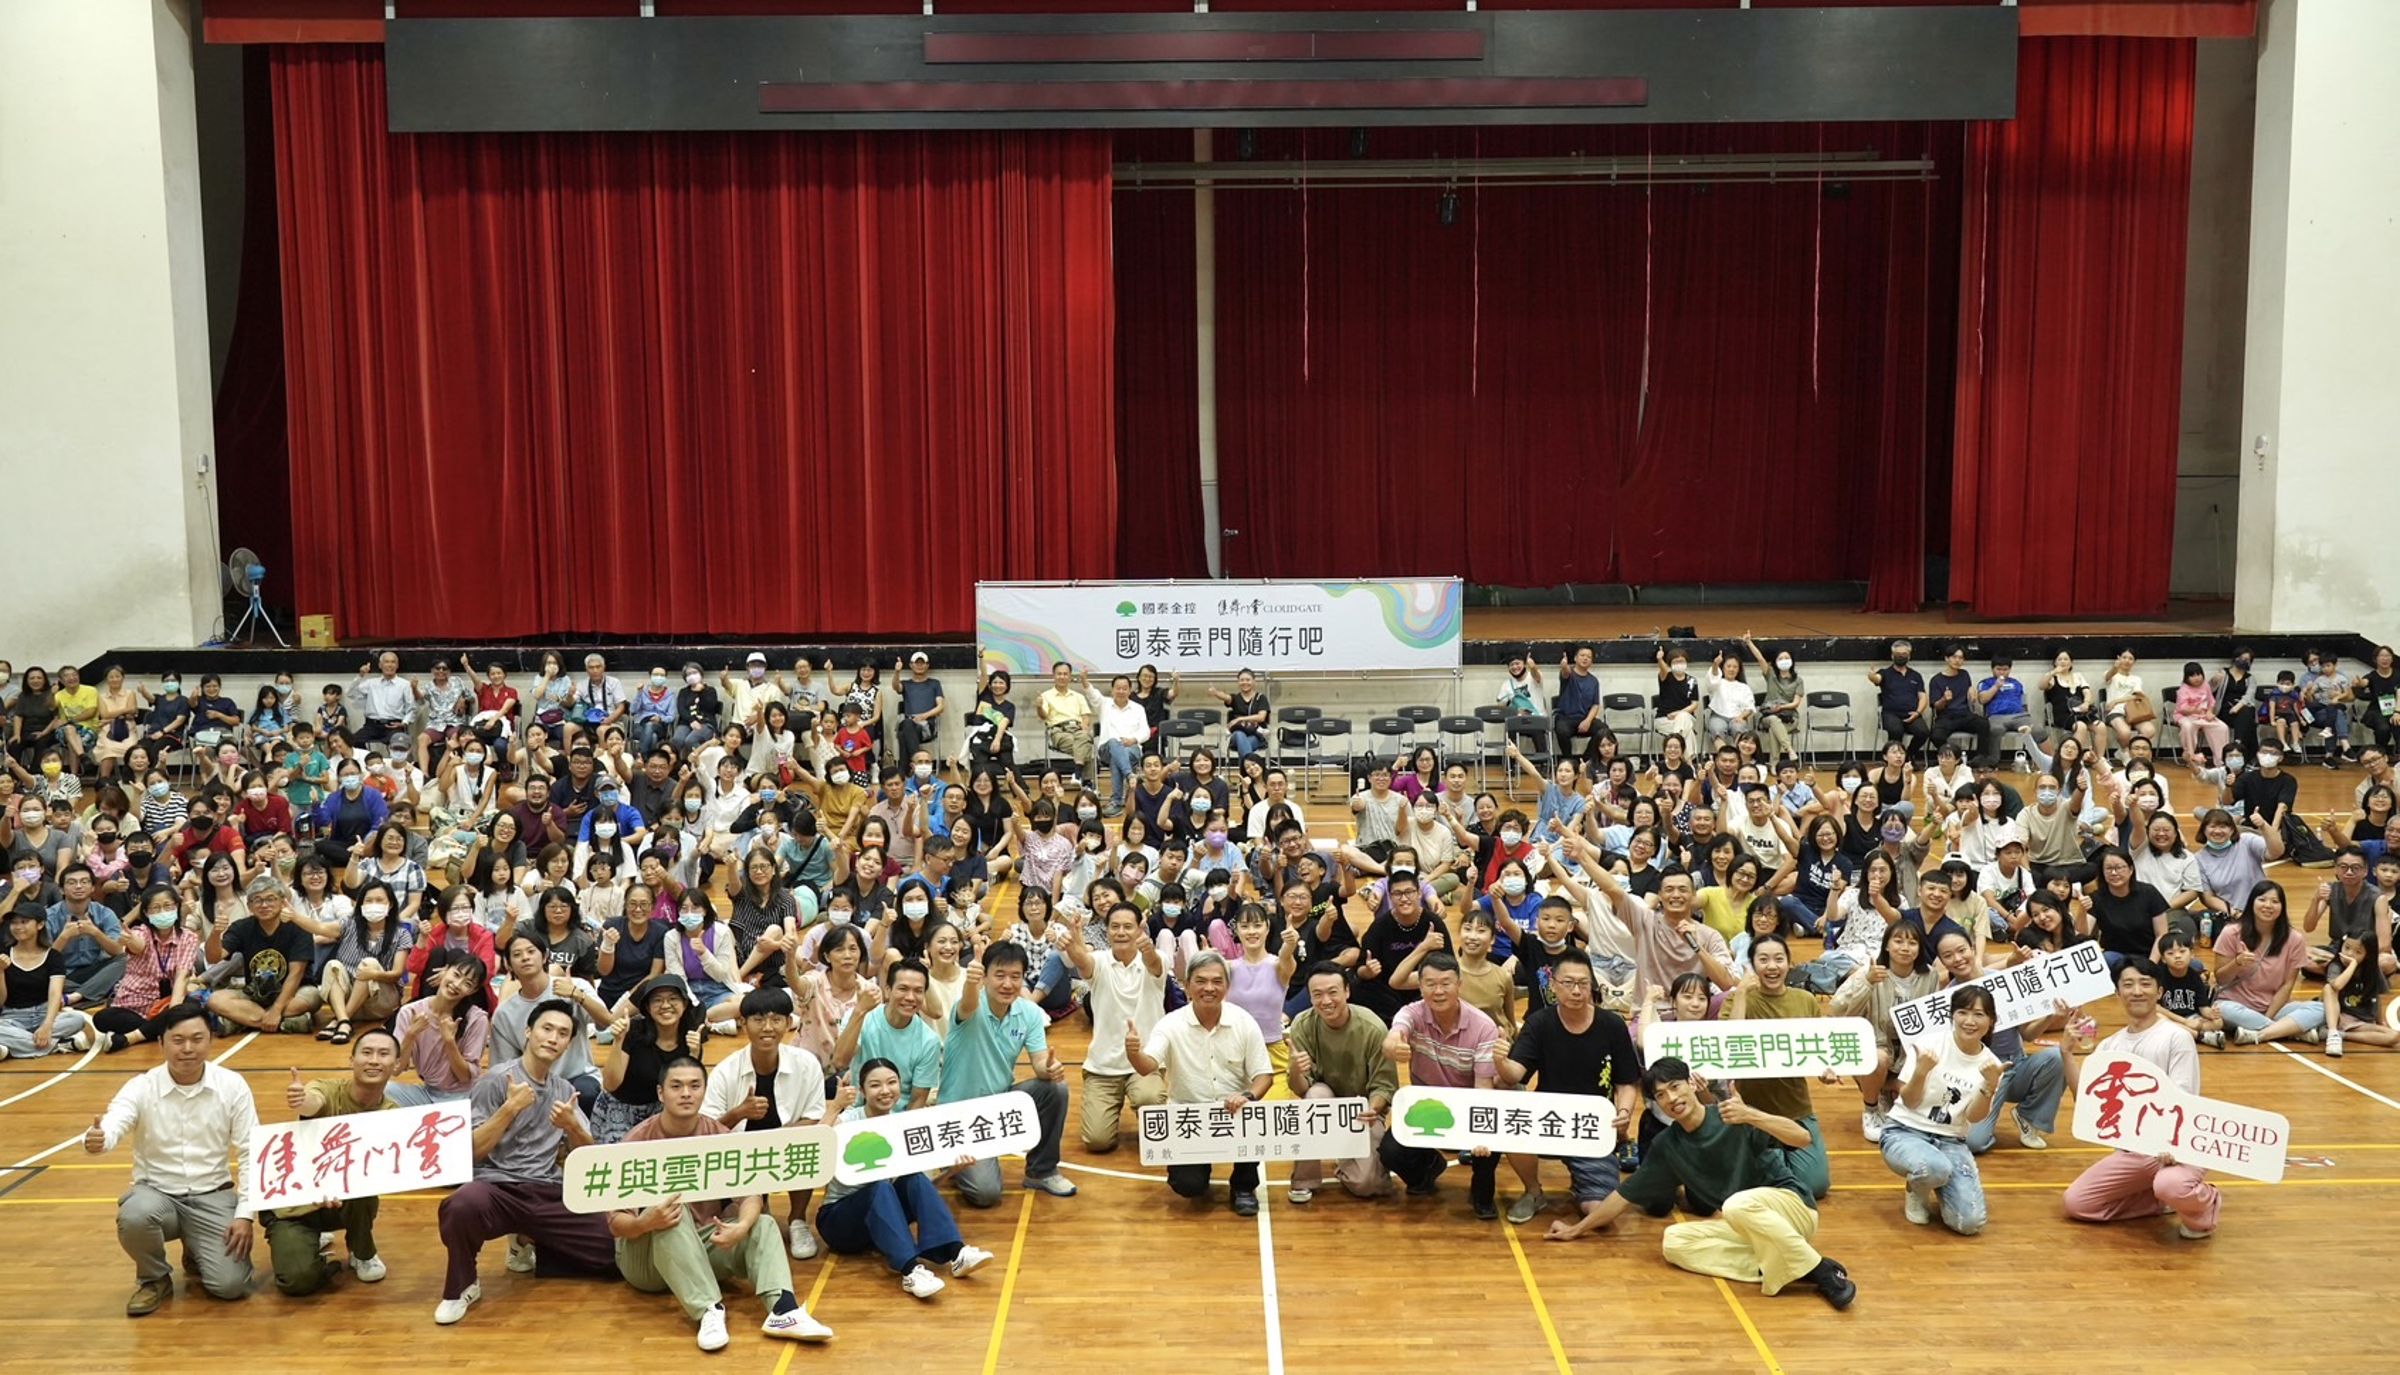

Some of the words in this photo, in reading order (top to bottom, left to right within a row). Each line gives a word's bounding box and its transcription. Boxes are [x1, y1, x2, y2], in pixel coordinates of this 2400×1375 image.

[1142, 602, 1197, 615] 國泰金控
[1115, 626, 1324, 660] 國泰雲門隨行吧
[1894, 945, 2104, 1036] 國泰門隨行吧
[1661, 1031, 1863, 1070] #與雲門共舞
[902, 1107, 1027, 1157] 國泰金控
[1143, 1103, 1366, 1142] 國泰雲門隨行吧
[1469, 1106, 1601, 1141] 國泰金控
[2193, 1113, 2278, 1147] CLOUD
[2190, 1134, 2252, 1163] GATE
[583, 1141, 821, 1199] #與雲門共舞
